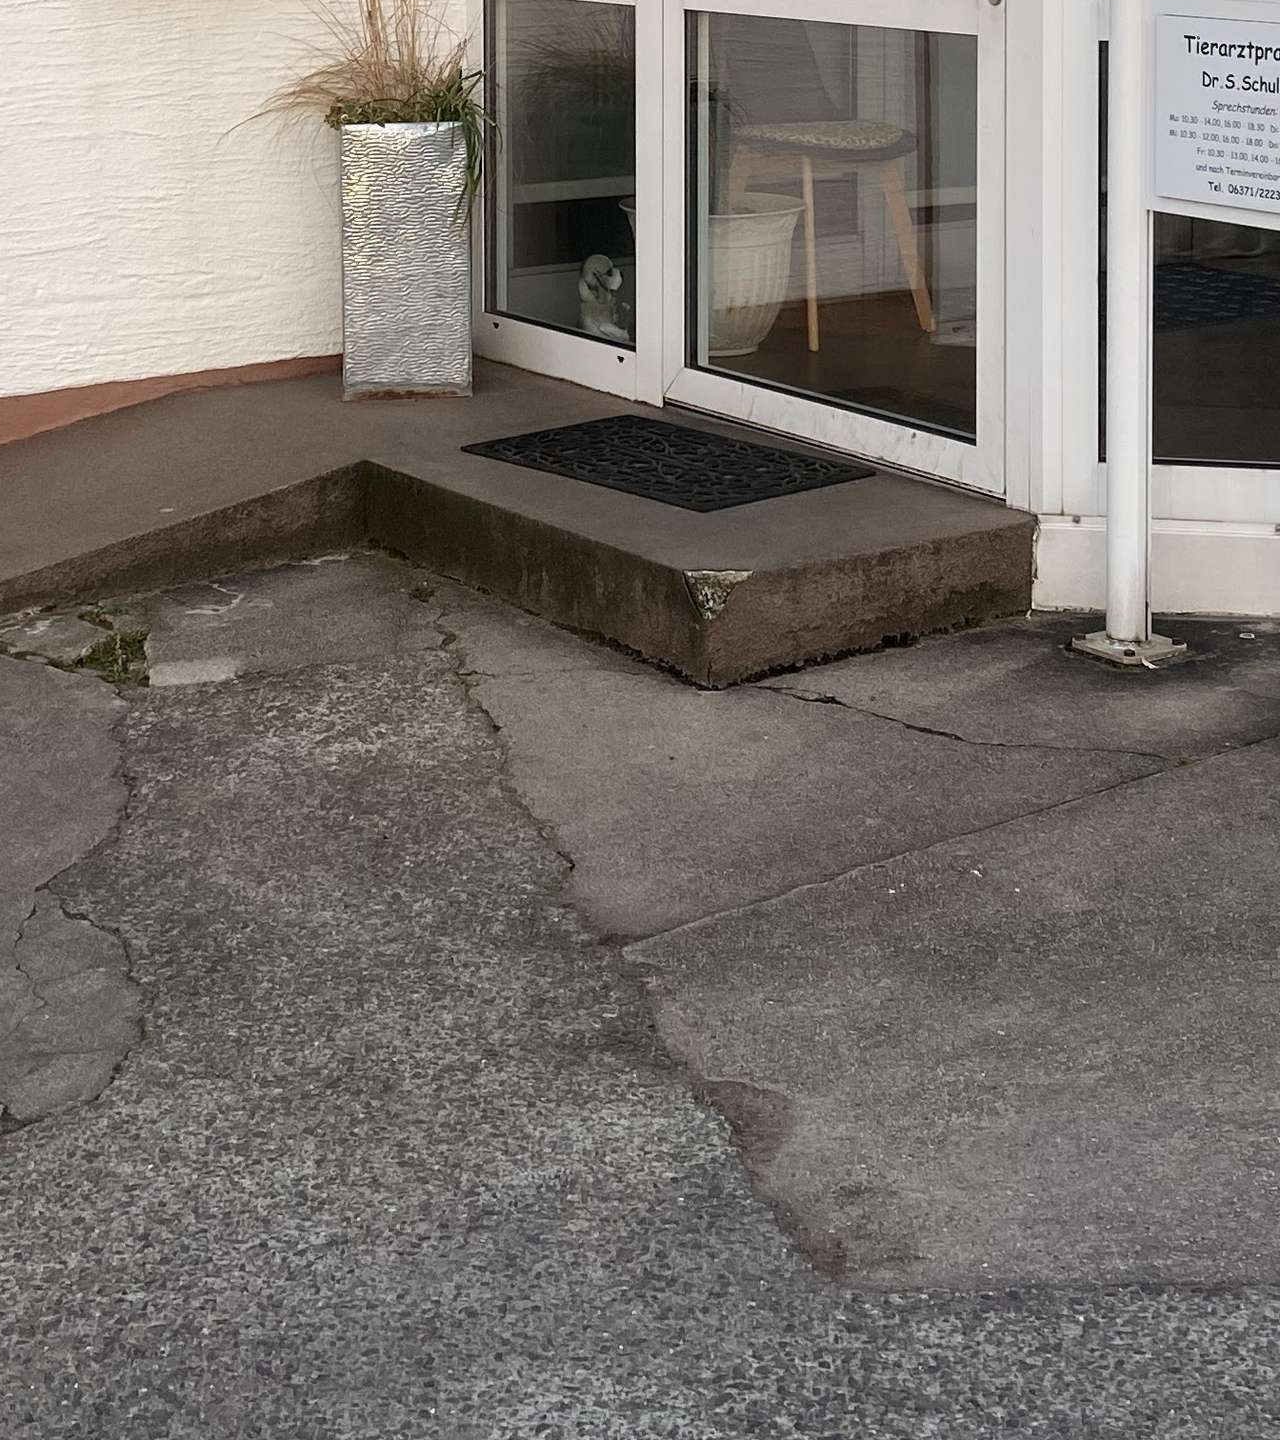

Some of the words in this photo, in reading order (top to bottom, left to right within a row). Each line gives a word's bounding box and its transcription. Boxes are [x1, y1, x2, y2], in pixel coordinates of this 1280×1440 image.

[1212, 100, 1279, 117] Sprechstunden:
[1195, 164, 1207, 172] und
[1209, 165, 1224, 174] nach
[1208, 181, 1224, 193] Tel.
[1228, 183, 1280, 201] 06371/2223
